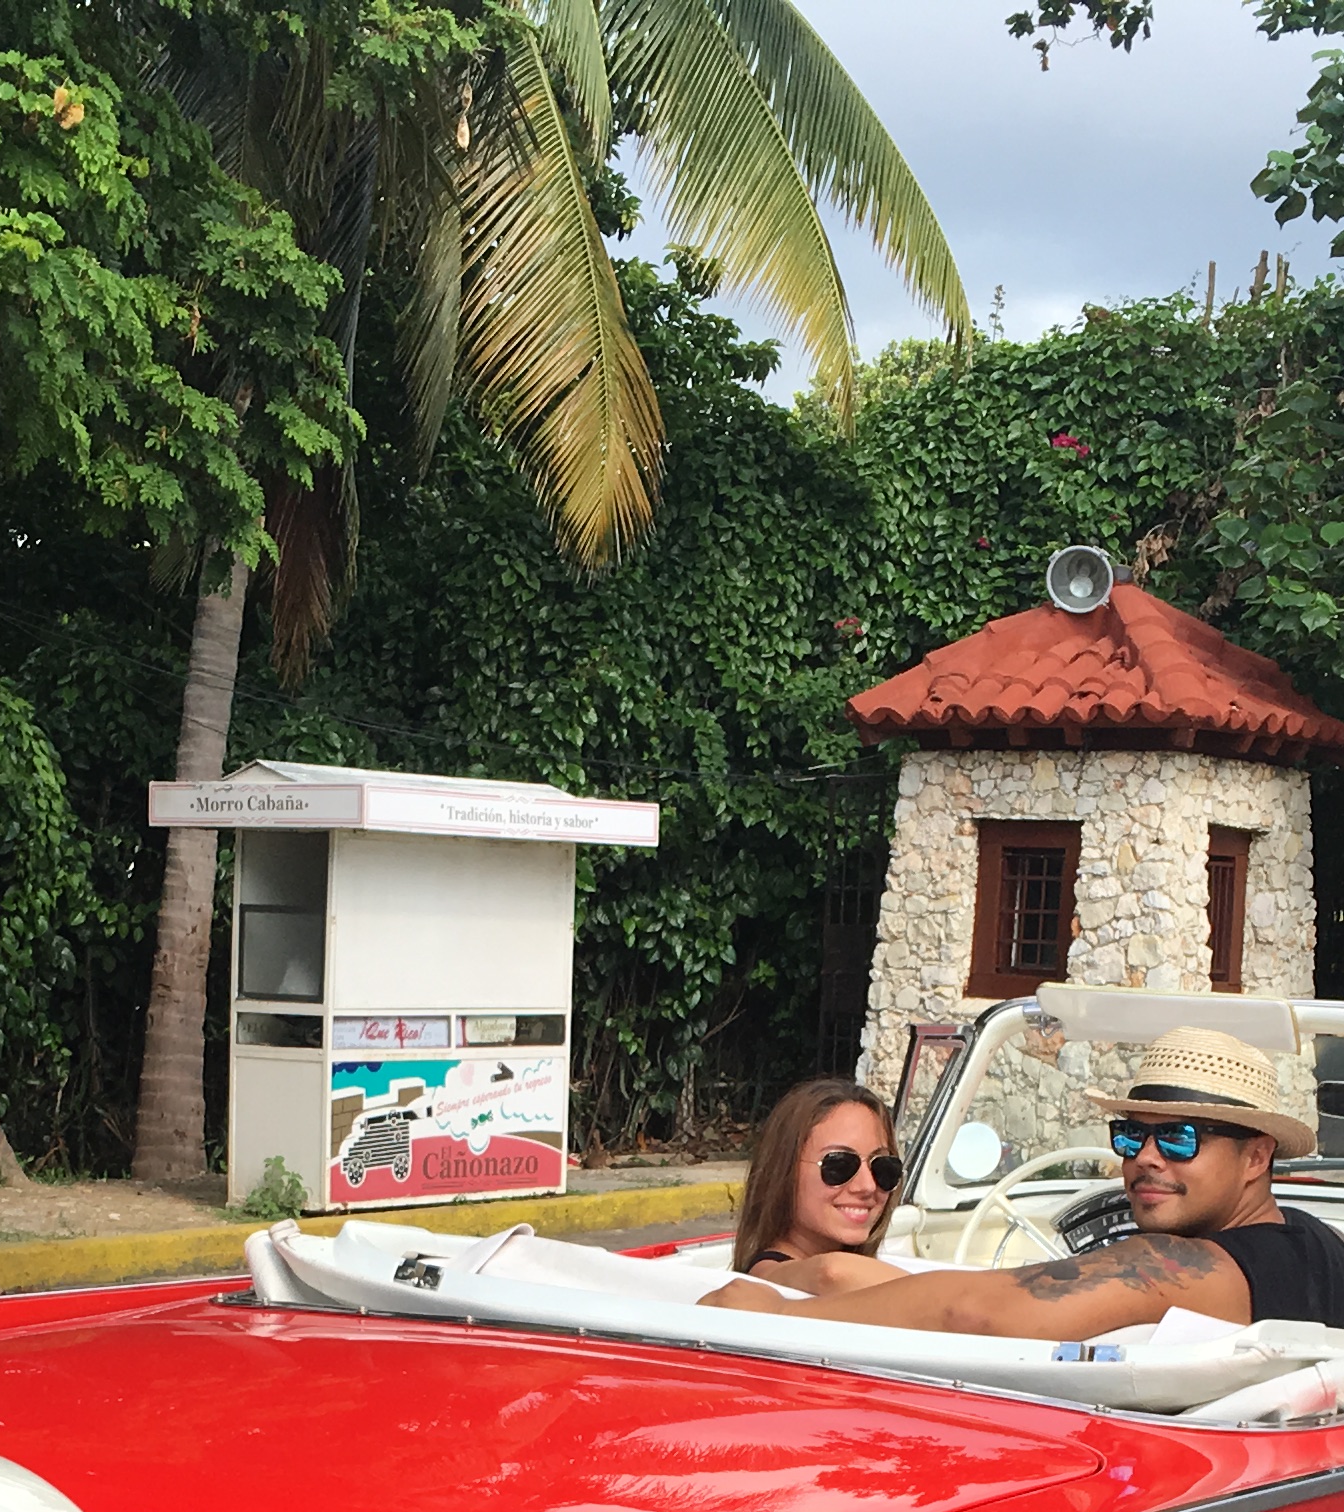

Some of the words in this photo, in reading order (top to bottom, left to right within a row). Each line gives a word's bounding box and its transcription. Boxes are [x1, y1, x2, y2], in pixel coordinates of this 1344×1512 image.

[196, 796, 244, 812] Morro
[247, 794, 304, 812] Cabaña
[554, 816, 562, 830] y
[441, 1146, 452, 1160] El
[422, 1151, 539, 1180] Cañonazo
